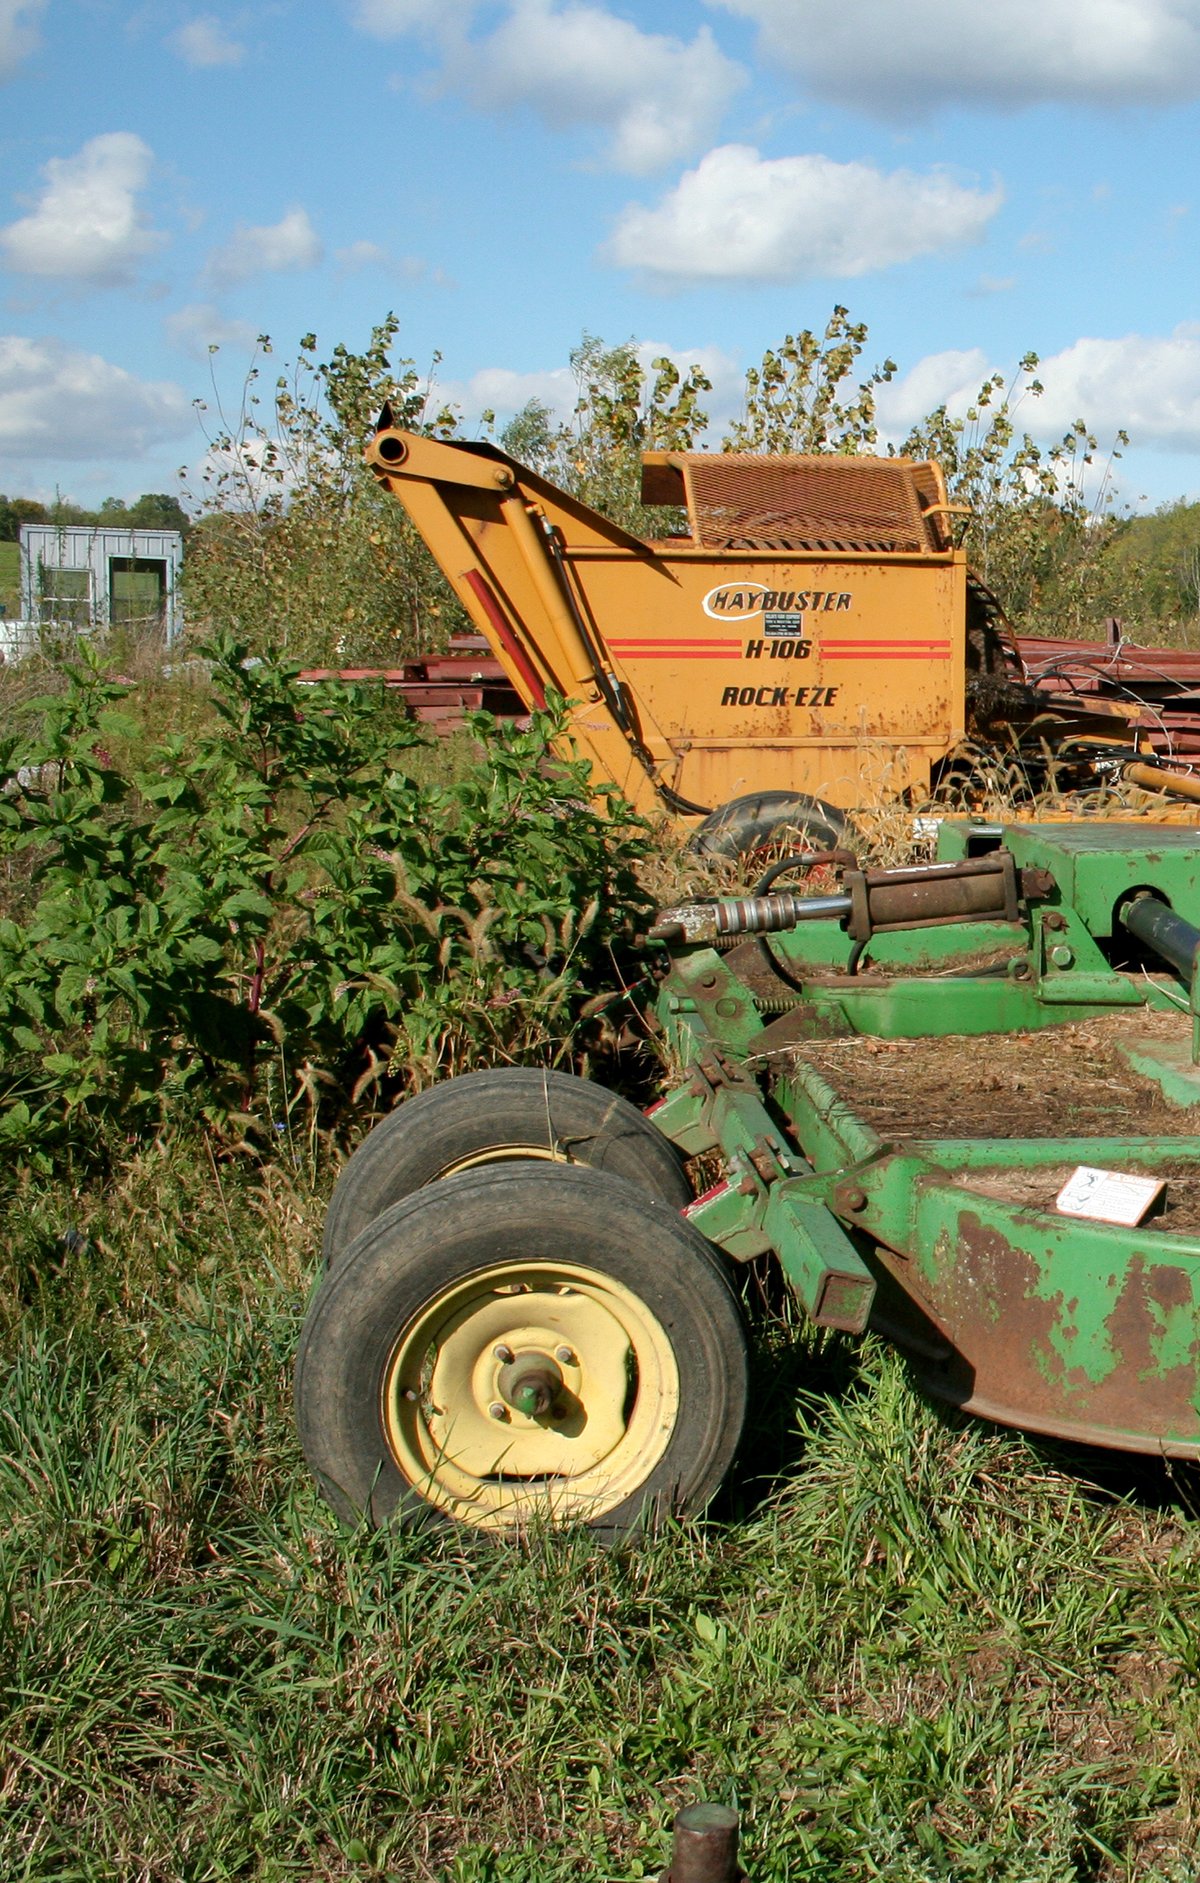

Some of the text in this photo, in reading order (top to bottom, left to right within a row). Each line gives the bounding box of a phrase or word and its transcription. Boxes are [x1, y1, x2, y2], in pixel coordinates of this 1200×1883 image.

[713, 591, 852, 612] HAYBUSTER
[745, 639, 813, 659] H-106
[720, 686, 839, 707] ROCK-EZE
